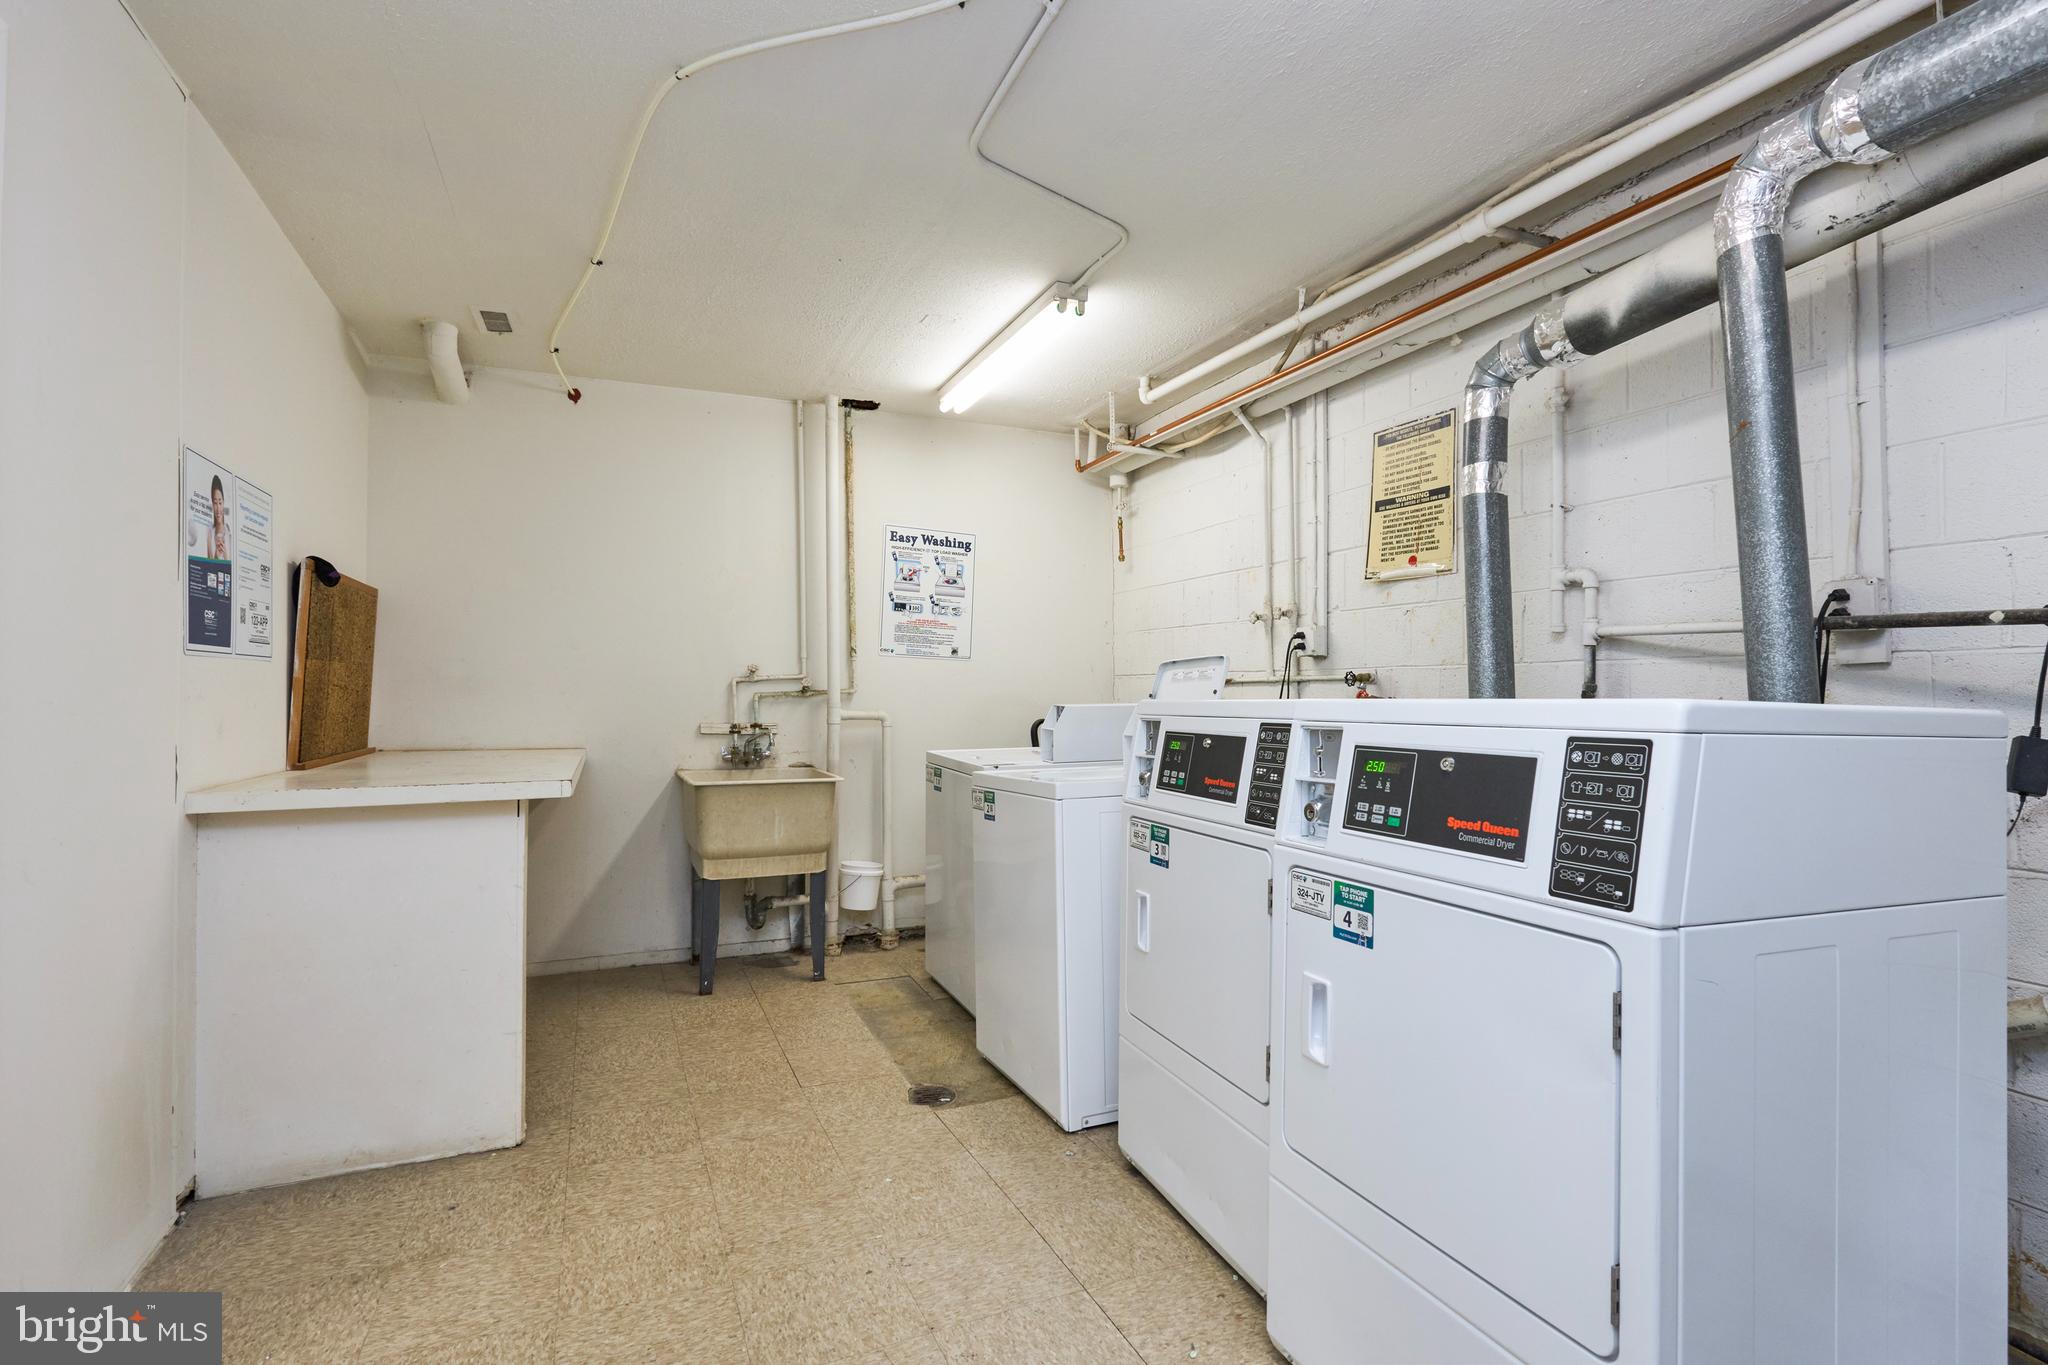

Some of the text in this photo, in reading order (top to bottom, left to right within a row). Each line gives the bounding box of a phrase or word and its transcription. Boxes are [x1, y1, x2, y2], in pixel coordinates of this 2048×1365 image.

[1395, 491, 1429, 503] WARNING
[890, 530, 971, 553] Easy Washing
[1366, 760, 1385, 772] 2.50
[1204, 777, 1219, 786] Speed
[1447, 816, 1521, 838] Speed Queen
[1458, 832, 1516, 851] Commercial Dryer
[1154, 843, 1160, 856] 3
[1297, 887, 1325, 903] 324-JTV
[1339, 885, 1368, 898] TAP PHONE
[1349, 893, 1366, 903] START
[1343, 910, 1352, 928] 4
